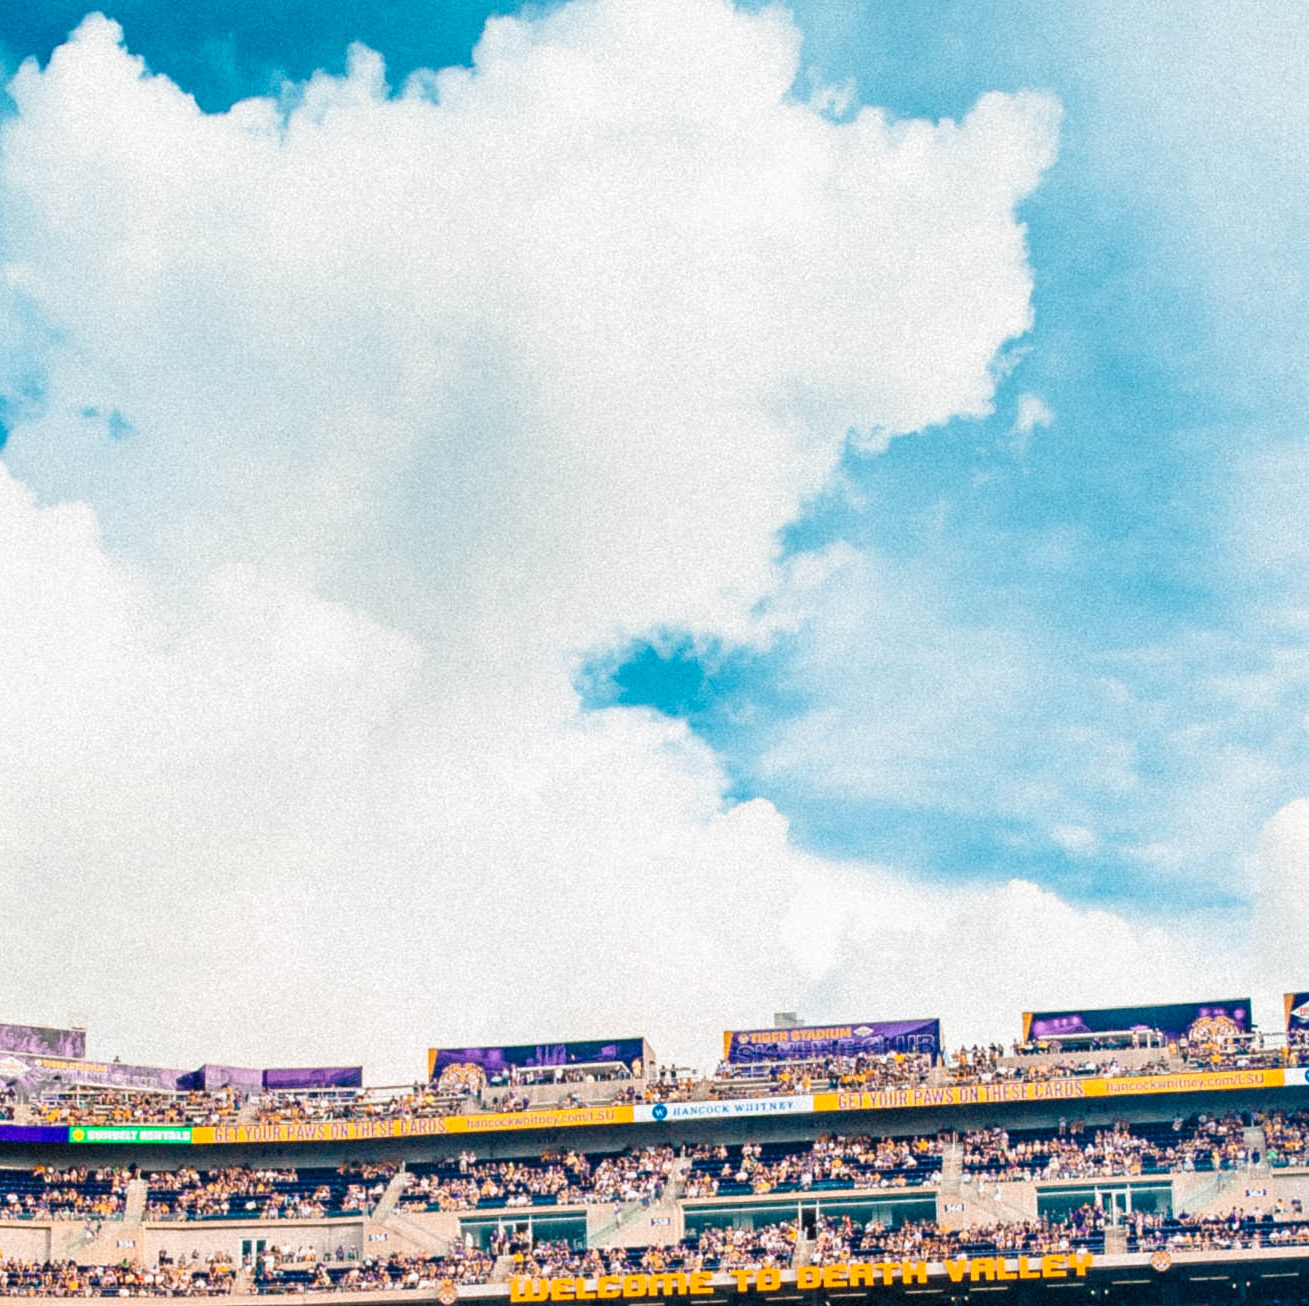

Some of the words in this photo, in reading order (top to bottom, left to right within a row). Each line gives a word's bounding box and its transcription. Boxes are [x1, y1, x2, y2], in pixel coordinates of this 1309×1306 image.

[749, 1031, 789, 1043] TIGER
[791, 1027, 851, 1041] STADIUM
[838, 1095, 864, 1109] GET
[870, 1093, 908, 1108] YOUR
[914, 1090, 953, 1106] PAWS
[960, 1088, 979, 1103] ON
[984, 1085, 1029, 1101] THESE
[673, 1103, 730, 1116] HANCOCK
[735, 1101, 794, 1114] WHITNEY
[215, 1128, 239, 1142] GET
[244, 1126, 281, 1141] YOUR
[287, 1125, 326, 1140] PAWS
[330, 1123, 349, 1139] ON
[354, 1121, 395, 1138] THESE
[510, 1272, 714, 1304] WELCOME
[730, 1268, 782, 1293] TO
[797, 1260, 928, 1290] DEATH
[944, 1253, 1092, 1282] VALLEY
